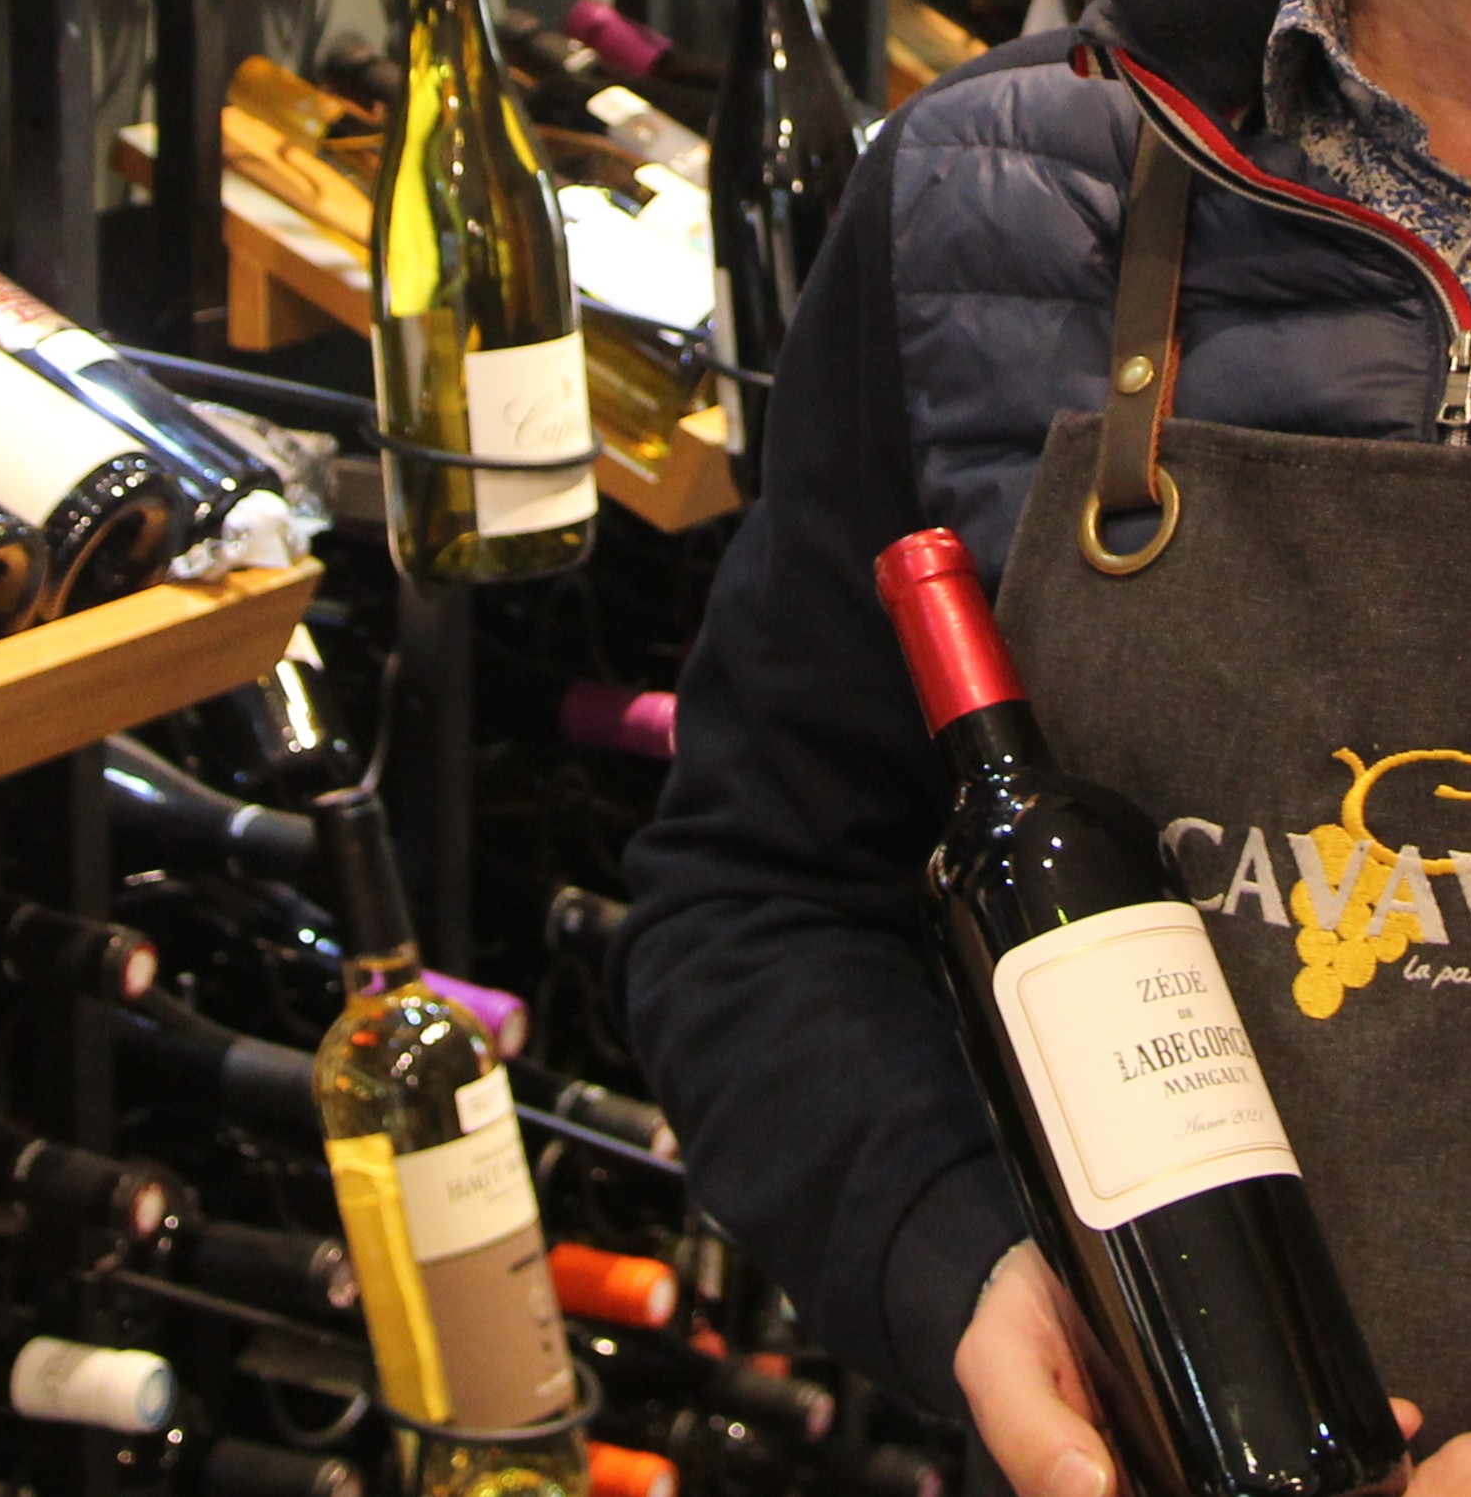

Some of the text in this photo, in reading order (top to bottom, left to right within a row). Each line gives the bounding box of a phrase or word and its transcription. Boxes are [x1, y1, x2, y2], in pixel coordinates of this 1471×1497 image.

[1402, 954, 1431, 980] la
[1136, 964, 1208, 1003] ZÉDÉ
[1177, 1007, 1194, 1020] DE
[1163, 1066, 1251, 1099] MARGAUX
